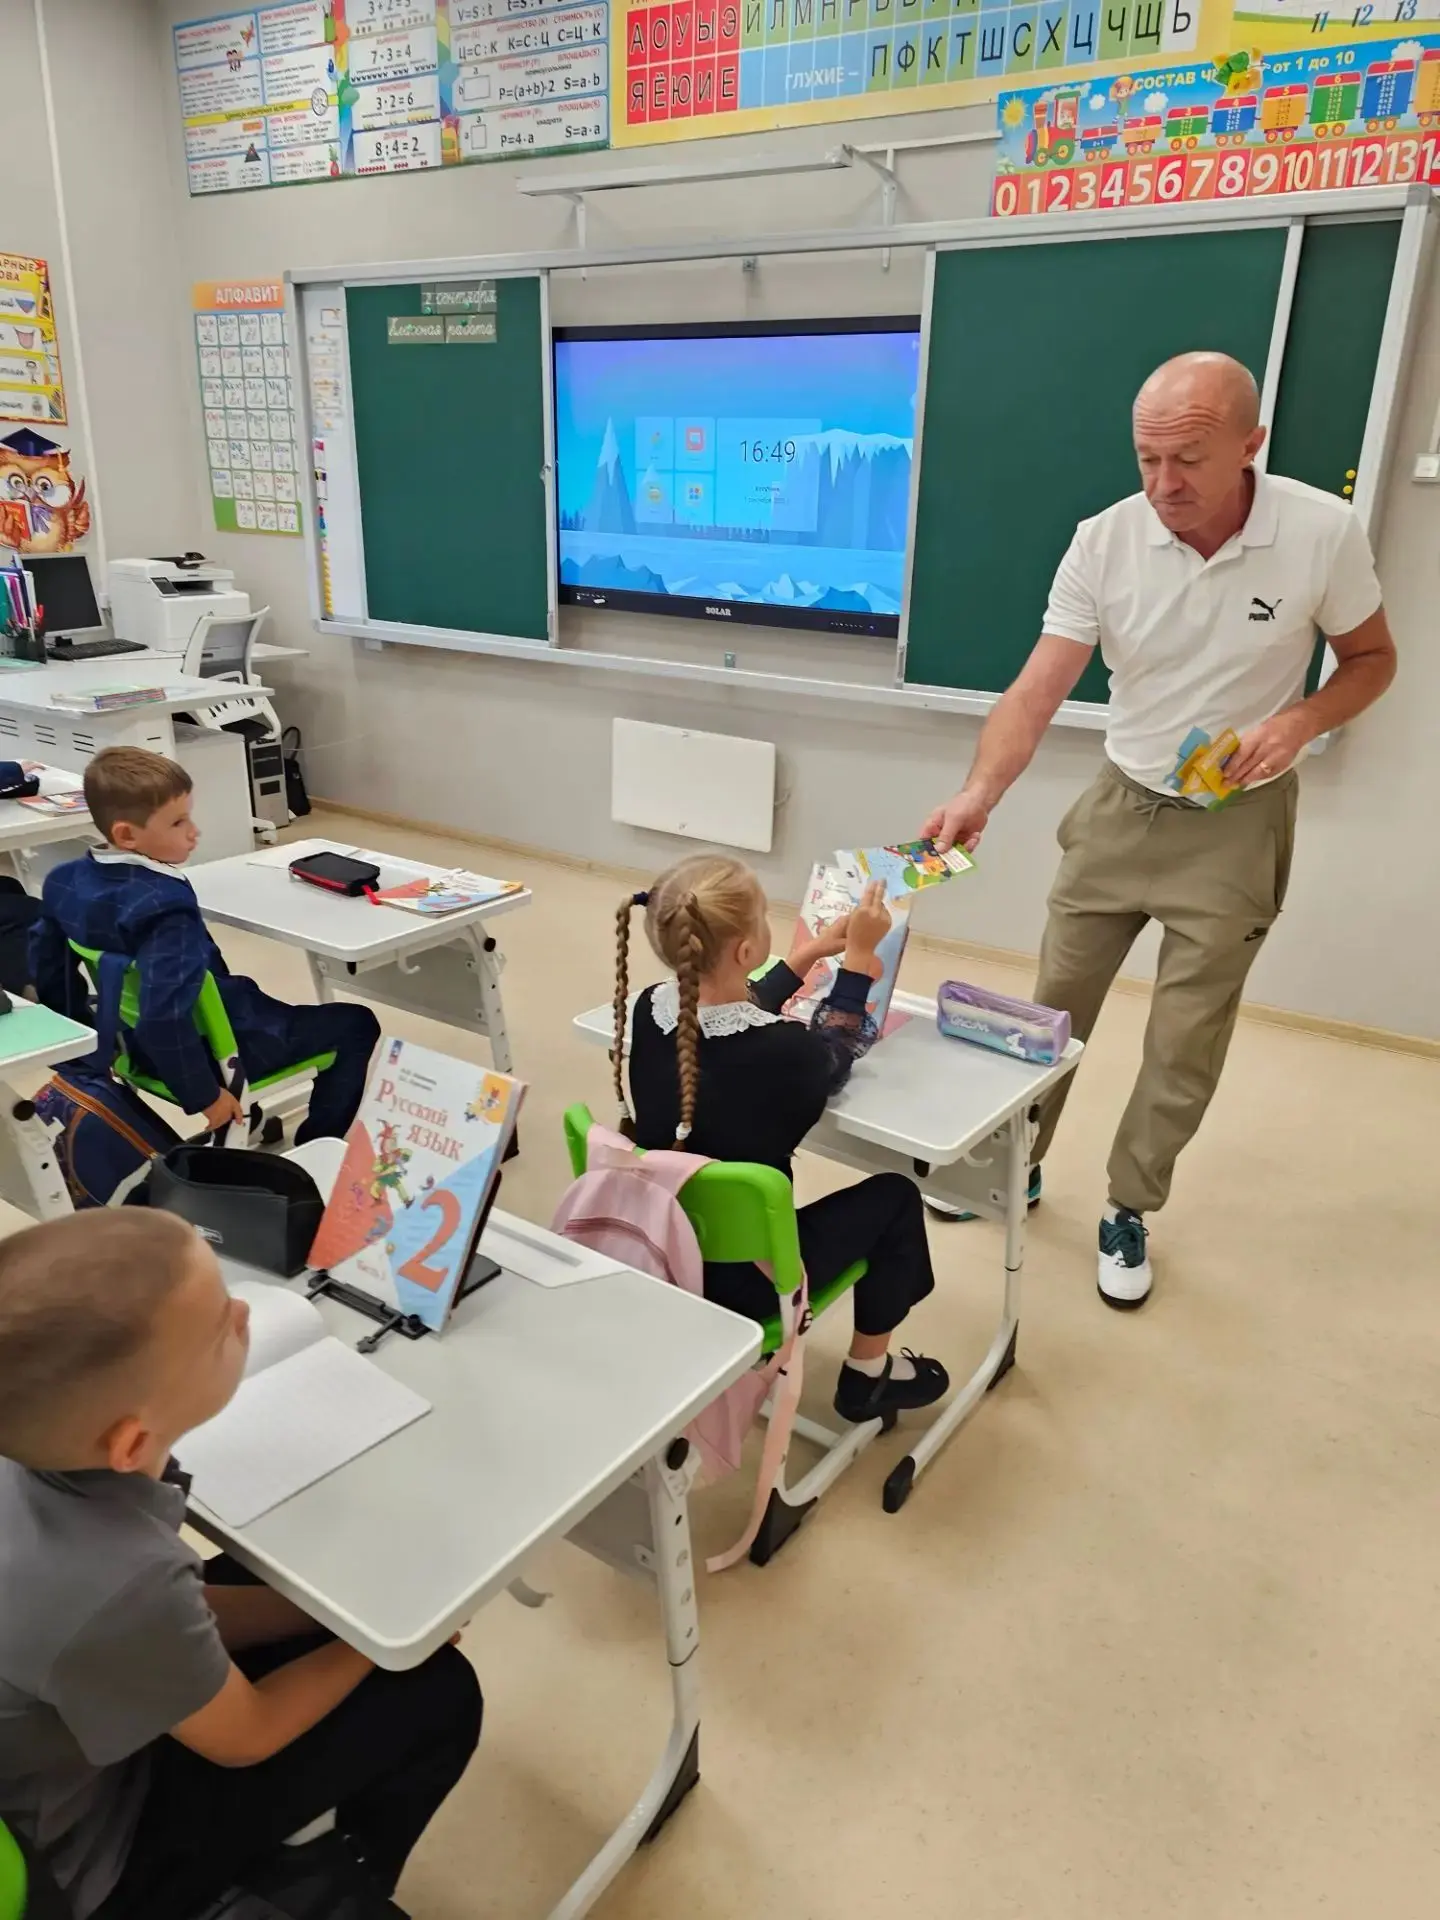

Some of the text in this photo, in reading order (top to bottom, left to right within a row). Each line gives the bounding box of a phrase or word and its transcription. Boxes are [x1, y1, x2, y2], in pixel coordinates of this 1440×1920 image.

[1310, 0, 1418, 33] 11 12 13
[785, 66, 845, 91] ГЛУХИЕ
[1134, 72, 1196, 91] СОСТАВ
[1272, 62, 1291, 74] от
[1296, 57, 1304, 70] 1
[1308, 56, 1330, 70] до
[1336, 50, 1356, 66] 10
[995, 181, 1017, 216] 0
[1027, 178, 1041, 214] 1
[1047, 175, 1072, 212] 2
[1075, 171, 1097, 209] 3
[1101, 168, 1125, 206] 4
[1129, 164, 1153, 203] 5
[1157, 159, 1183, 200] 6
[1188, 158, 1215, 197] 7
[1218, 155, 1246, 195] 8
[1252, 153, 1279, 194] 9
[1283, 150, 1314, 192] 10
[1318, 147, 1348, 188] 11
[1351, 143, 1383, 185] 12
[1386, 139, 1418, 182] 13
[216, 286, 280, 304] АЛФАВИТ
[740, 440, 796, 463] 16:49
[705, 606, 731, 617] SOLAR
[374, 1077, 449, 1128] Русский
[397, 1188, 461, 1294] 2
